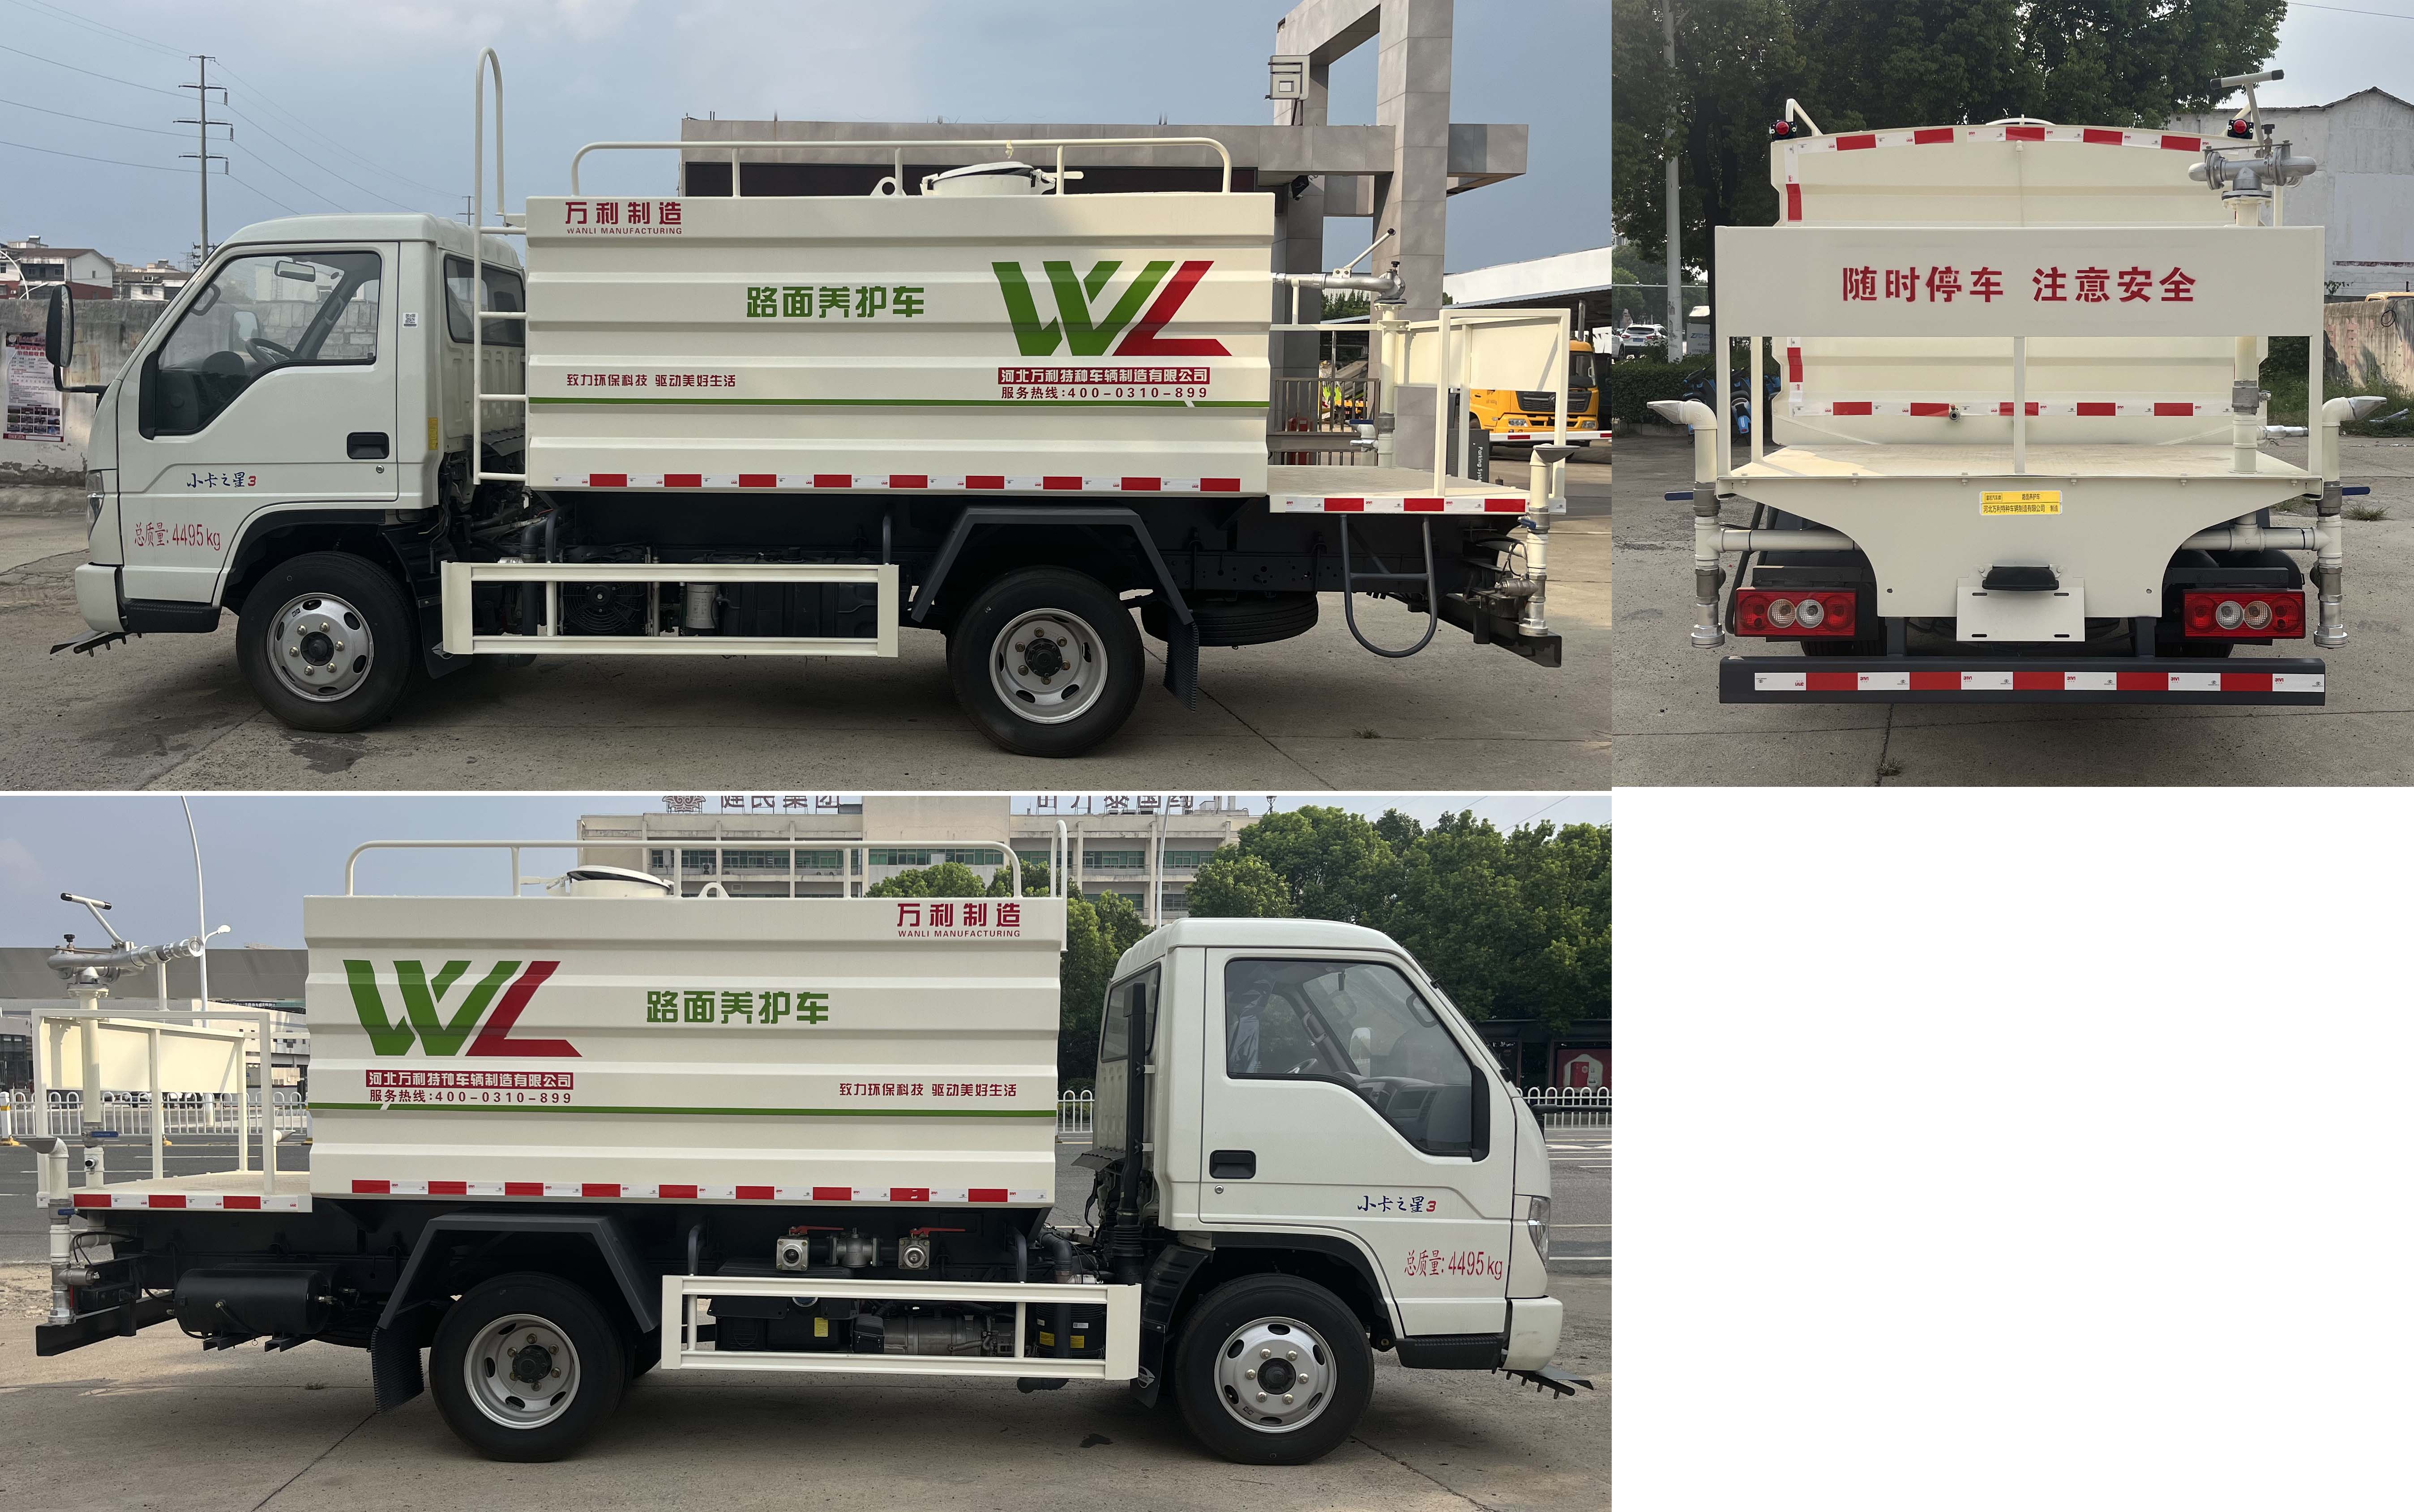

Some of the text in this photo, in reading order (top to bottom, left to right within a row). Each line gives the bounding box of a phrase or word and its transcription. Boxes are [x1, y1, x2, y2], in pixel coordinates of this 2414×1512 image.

[565, 202, 681, 225] 万利制造
[1843, 266, 2196, 303] 随时停车 注意安全
[747, 286, 924, 317] 路面养护车
[567, 374, 736, 387] 致力环保科技 驱动美好生活
[1001, 369, 1208, 383] 河北万利特种车辆制造有限公司
[897, 903, 1020, 927] 万利制造
[647, 991, 829, 1025] 路面养护车
[369, 1072, 572, 1088] 河北万利特种车辆制造有限公司
[839, 1083, 1017, 1097] 致力环保科技 驱动美好生活
